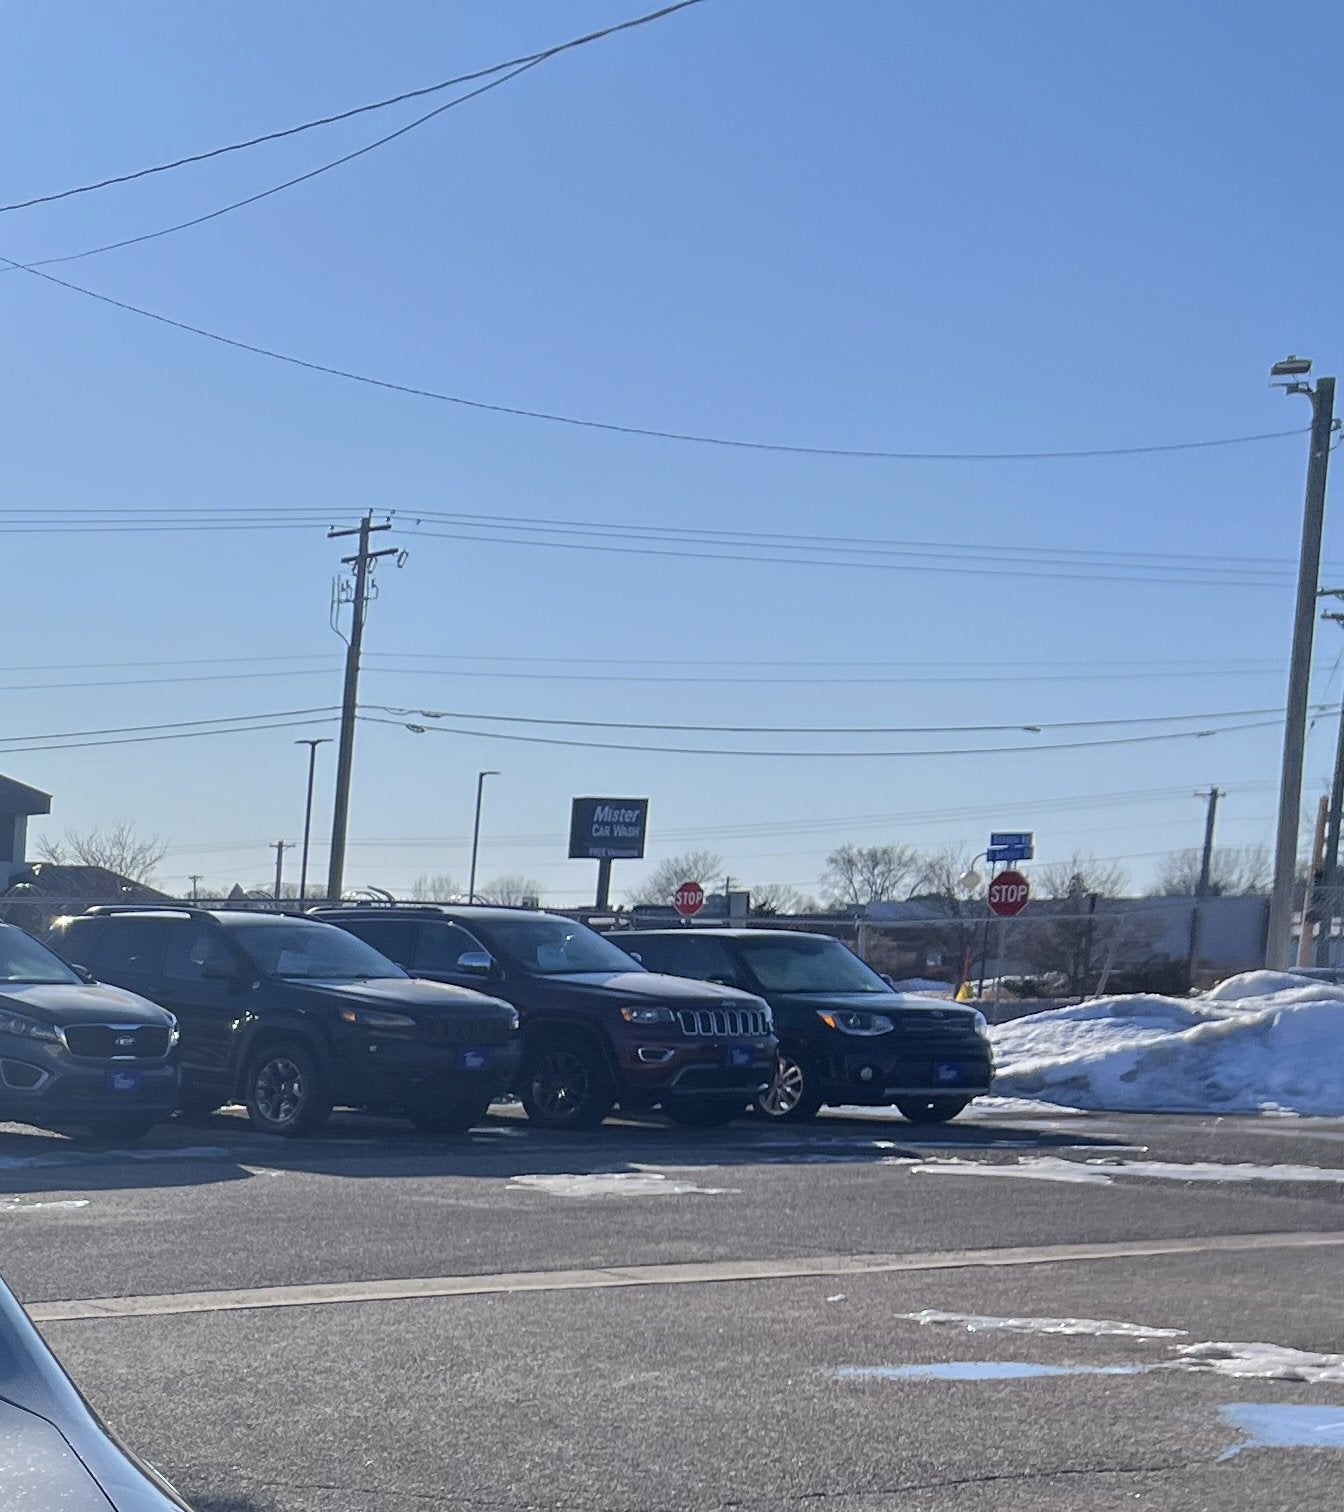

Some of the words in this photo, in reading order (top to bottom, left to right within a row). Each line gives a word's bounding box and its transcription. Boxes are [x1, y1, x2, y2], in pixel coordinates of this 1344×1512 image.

[593, 805, 640, 823] Mister
[676, 891, 703, 905] STOP
[991, 884, 1028, 903] STOP
